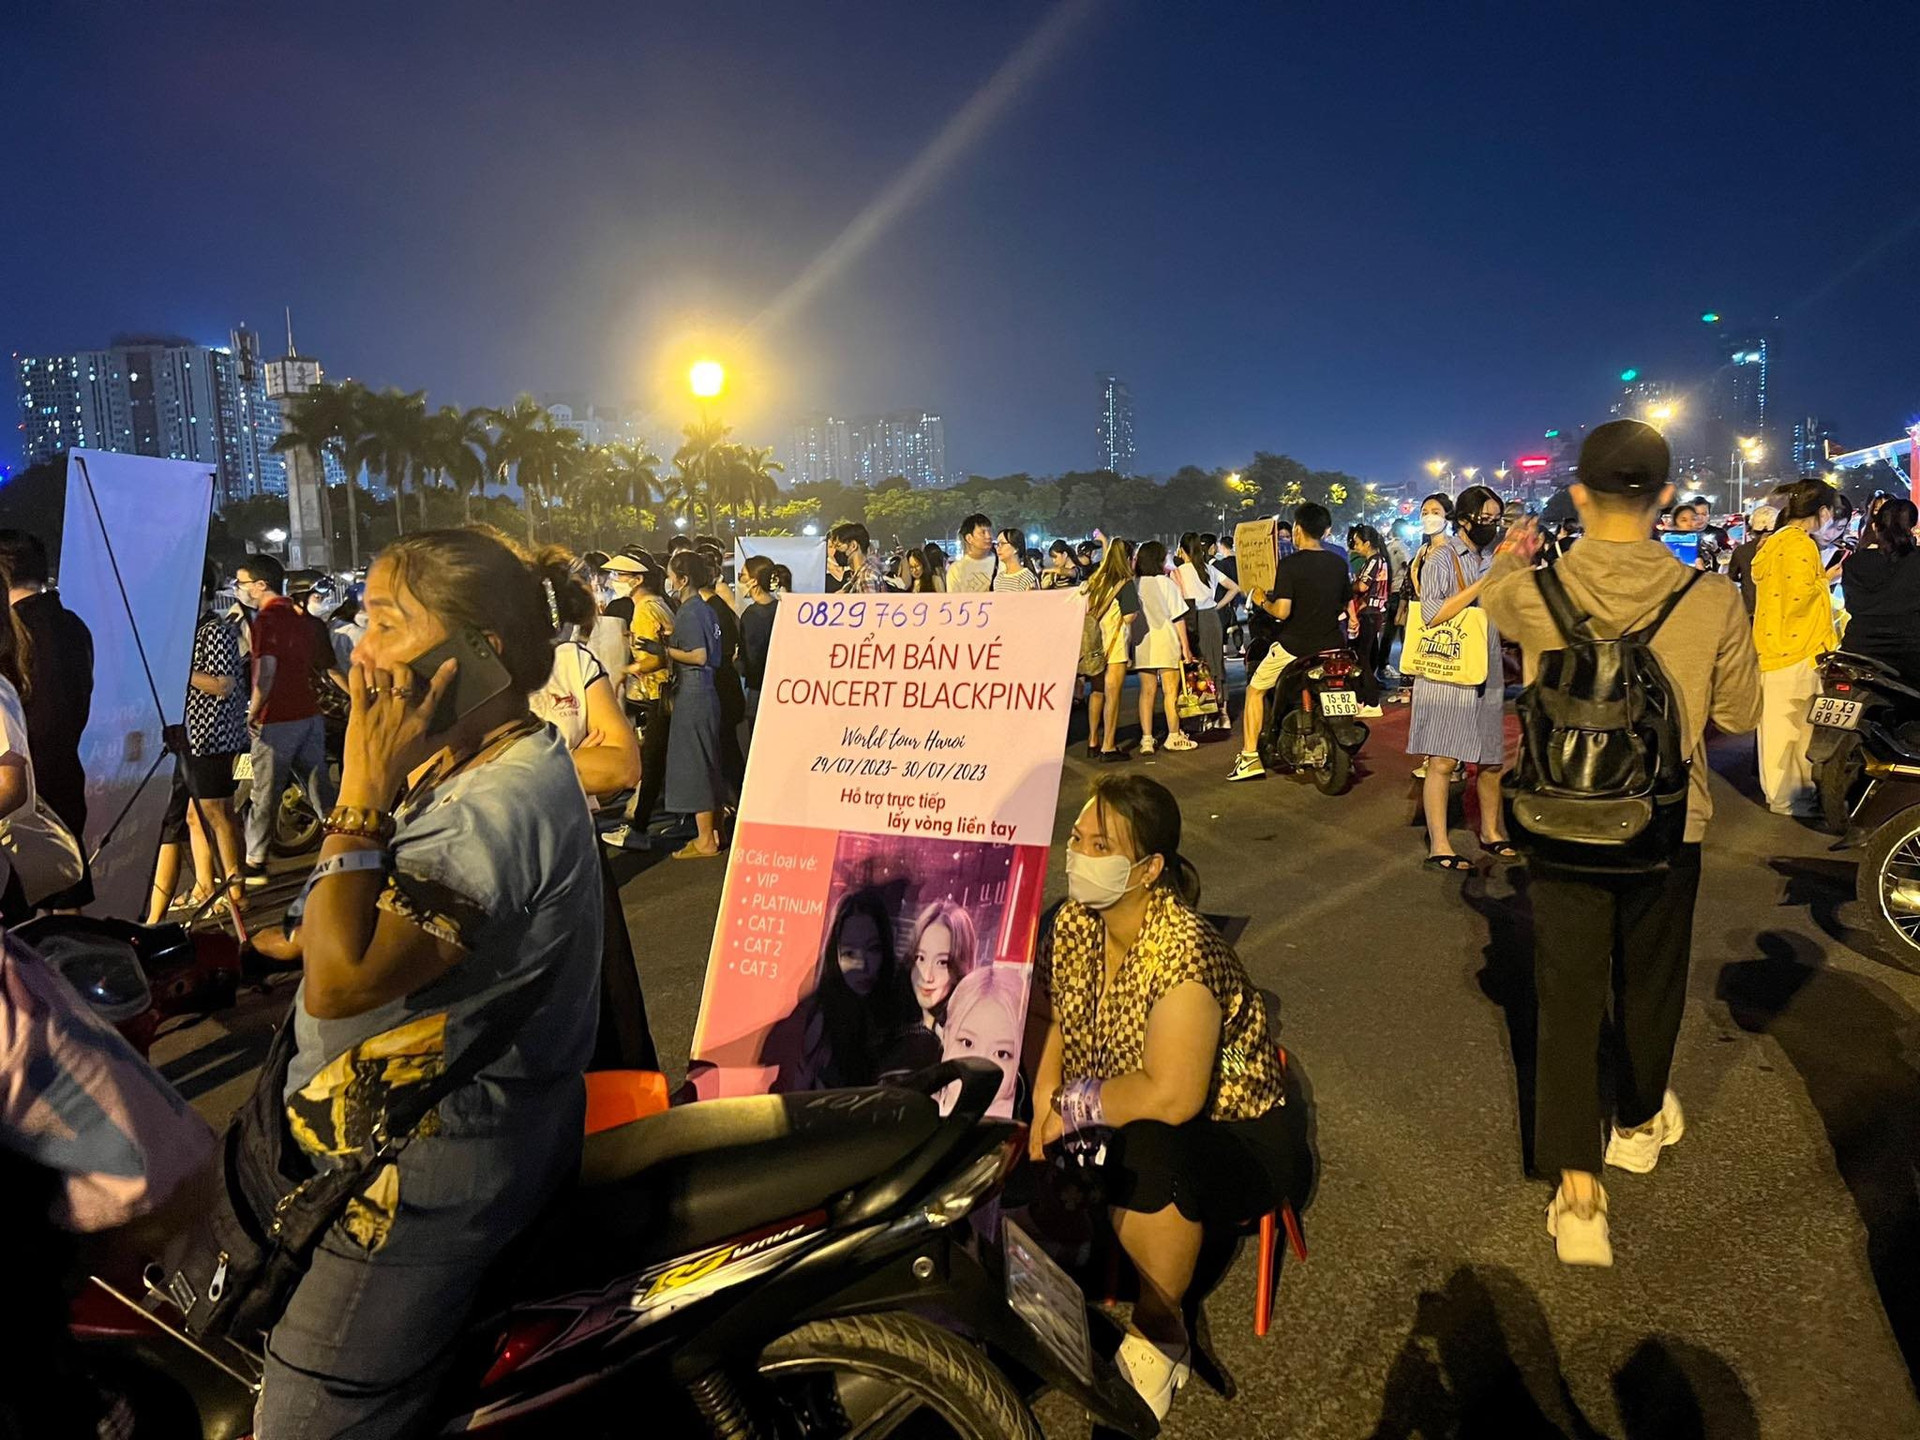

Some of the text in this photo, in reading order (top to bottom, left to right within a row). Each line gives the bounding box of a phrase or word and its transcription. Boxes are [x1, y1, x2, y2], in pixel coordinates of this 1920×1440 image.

[798, 601, 992, 628] 0829 769 555
[829, 632, 1003, 671] ĐIỂM BÁN VÉ
[776, 678, 1057, 711] CONCERT BLACKPINK
[1815, 711, 1851, 726] 8837
[841, 724, 965, 751] World tour Hanoi
[901, 760, 988, 781] 30/07/2023
[865, 791, 885, 810] trợ
[887, 792, 915, 811] trực
[919, 792, 946, 813] tiếp
[887, 811, 1017, 841] lấy vòng liền tay
[746, 849, 769, 866] Các
[772, 850, 797, 870] loại
[757, 872, 779, 889] VIP
[752, 893, 823, 916] PLATINUM
[748, 915, 785, 935] CAT 1
[744, 937, 782, 957] CAT 2
[740, 959, 778, 980] CAT 3
